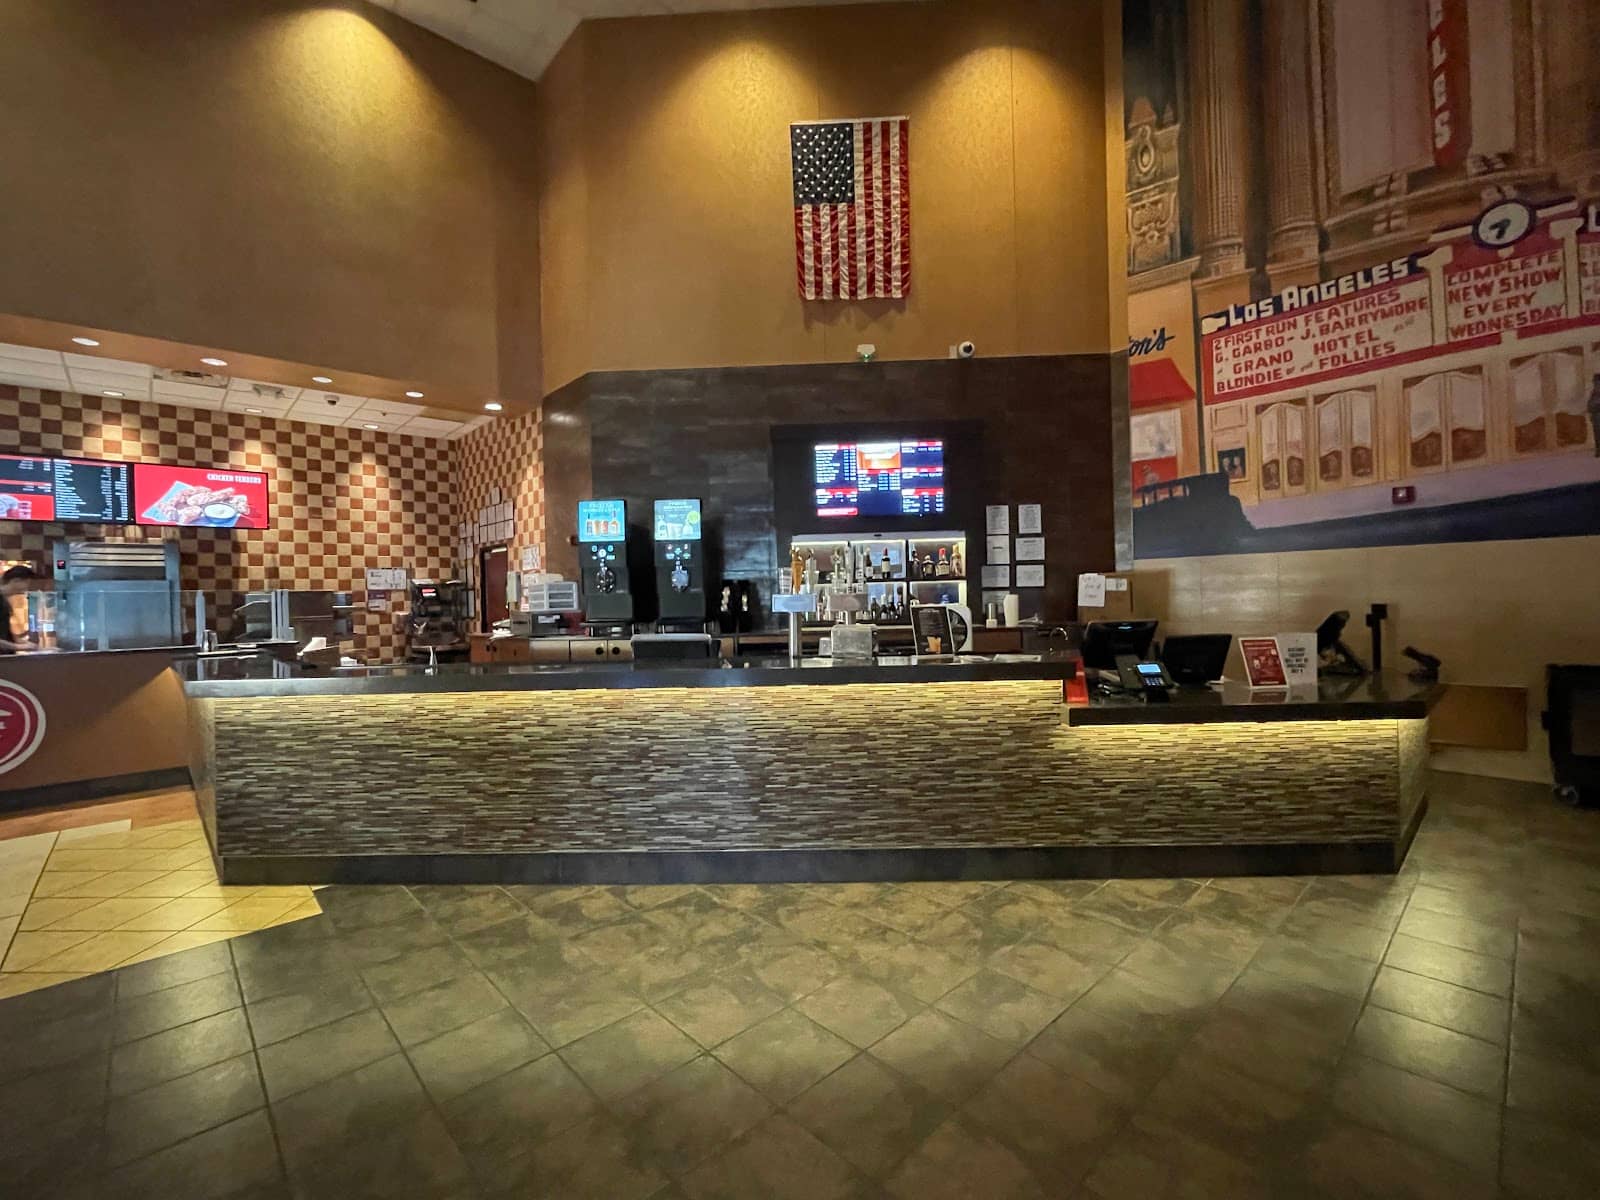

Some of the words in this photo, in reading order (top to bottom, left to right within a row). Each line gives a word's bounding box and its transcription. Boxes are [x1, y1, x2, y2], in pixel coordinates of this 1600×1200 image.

[1447, 248, 1562, 287] COMPLETE
[1448, 280, 1494, 305] NEW
[1499, 266, 1562, 294] SHOW
[1224, 328, 1263, 348] FIRST
[1265, 318, 1297, 337] RUN
[1303, 287, 1401, 327] FEATURES
[1449, 302, 1565, 338] WEDNESDAY
[1464, 291, 1536, 319] EVERY
[1128, 326, 1176, 357] on's
[1232, 335, 1285, 359] GARBO
[1319, 297, 1428, 337] BARRYMORE
[1216, 368, 1283, 392] BLONDIE
[1319, 341, 1395, 370] FOLLIES
[1233, 349, 1293, 374] GRAND
[1313, 329, 1380, 355] HOTEL
